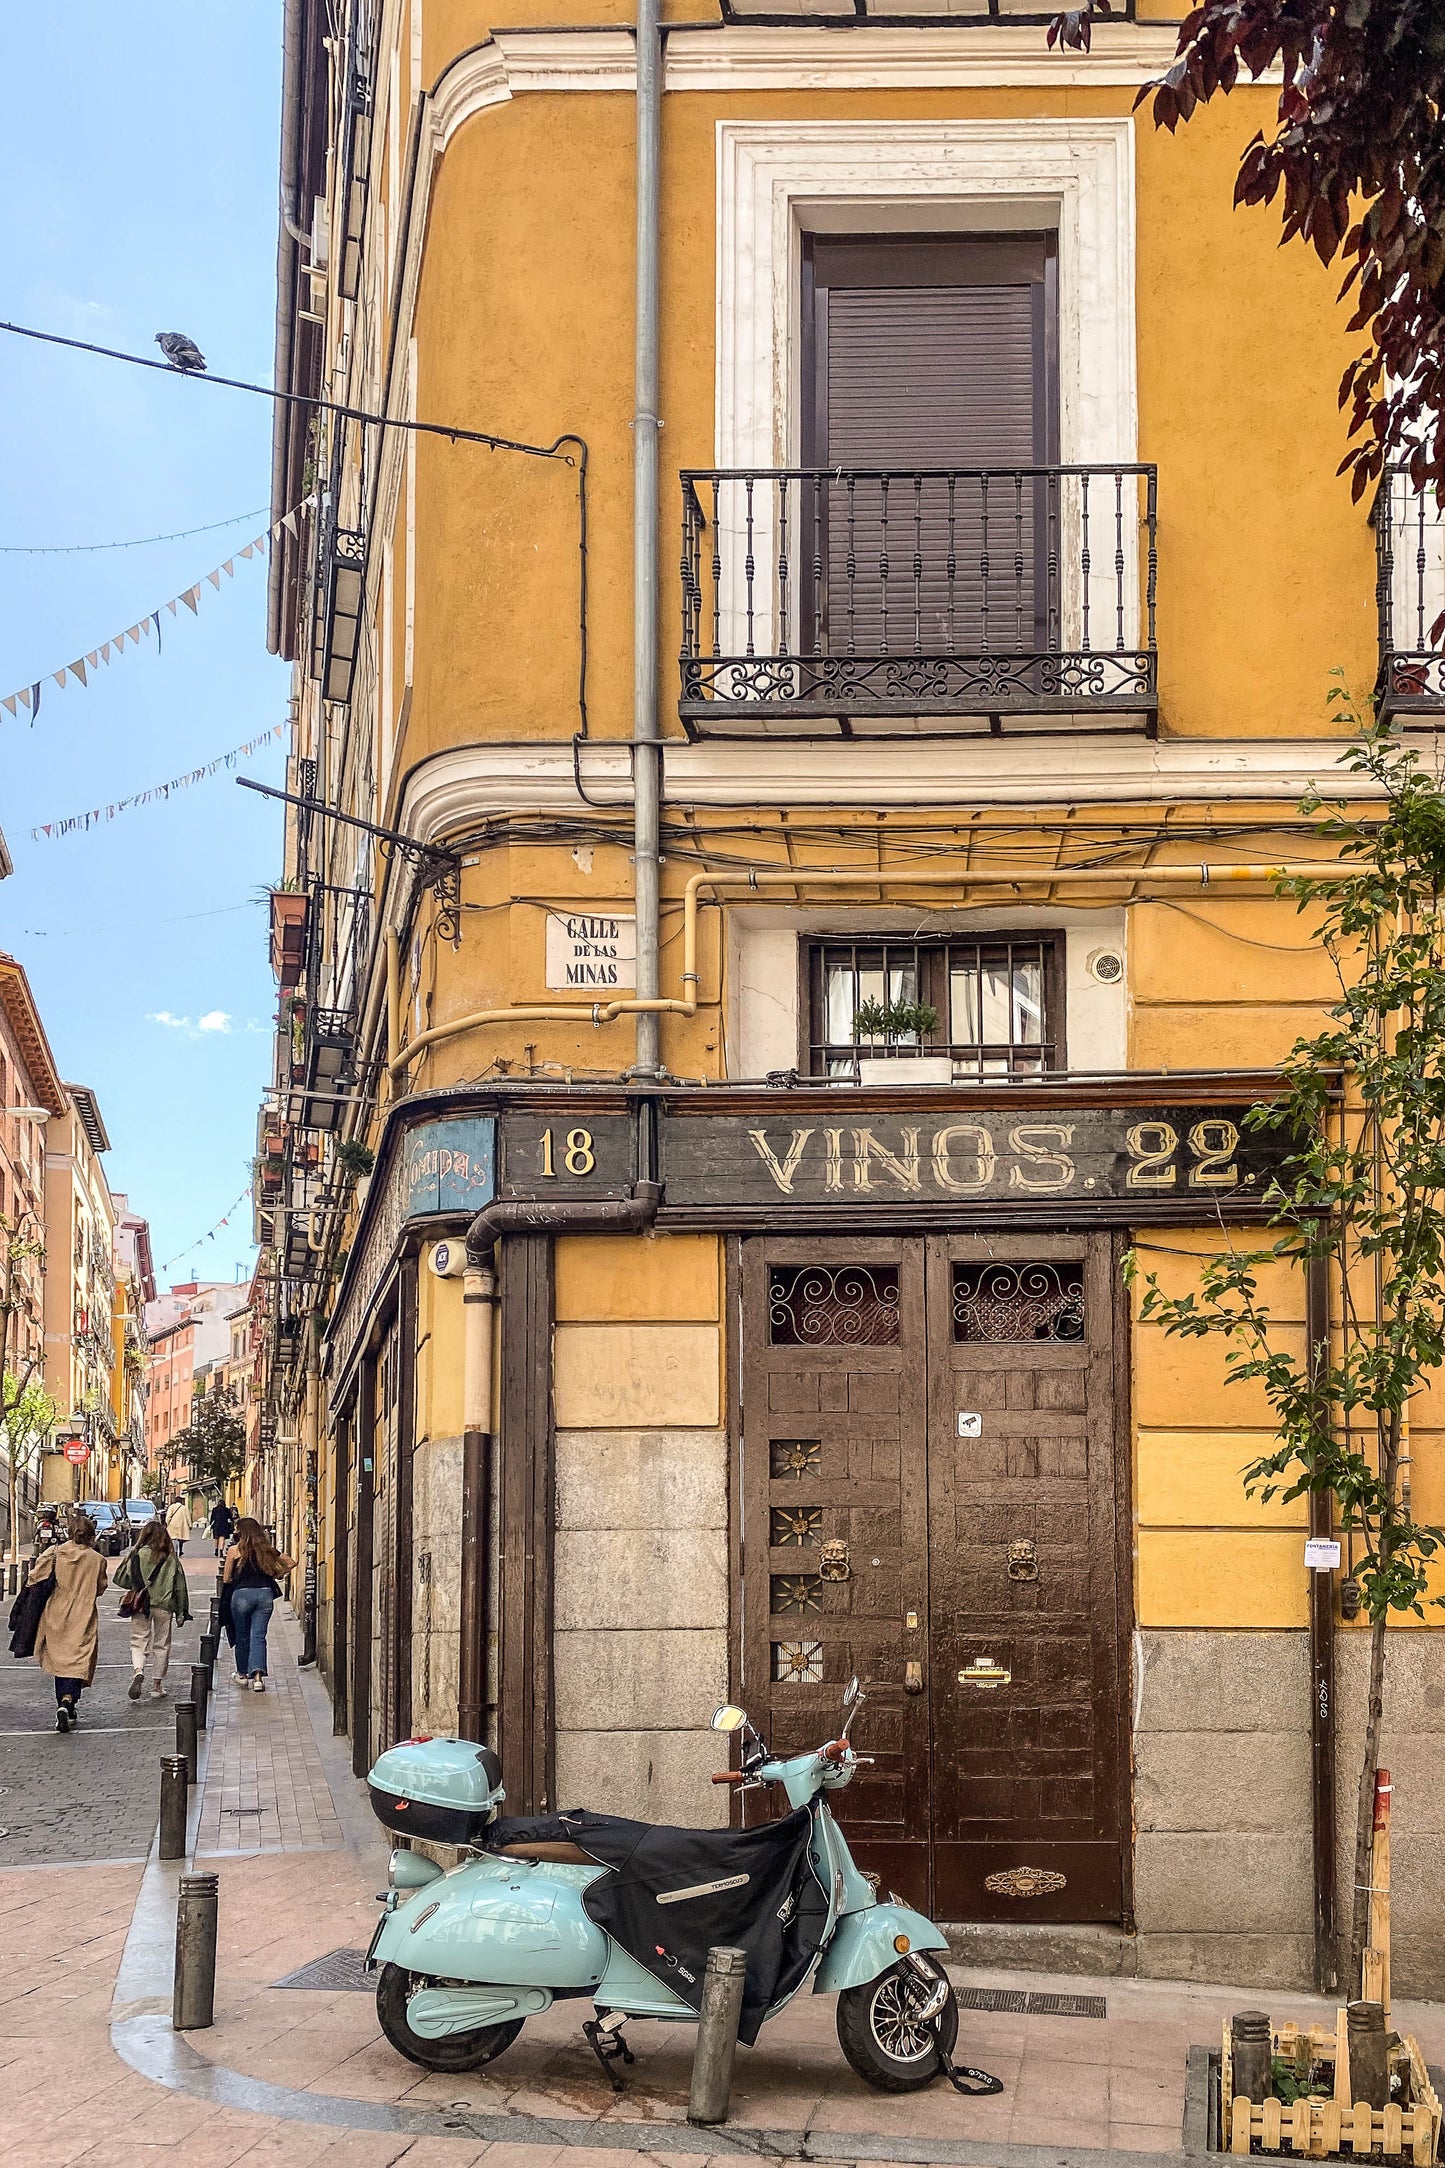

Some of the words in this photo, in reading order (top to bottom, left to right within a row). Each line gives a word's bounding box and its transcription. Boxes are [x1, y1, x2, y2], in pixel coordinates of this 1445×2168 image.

[567, 918, 619, 939] CALLE
[574, 945, 590, 957] DE
[594, 945, 617, 957] LAS
[566, 963, 618, 984] MINAS
[538, 1127, 597, 1177] 18
